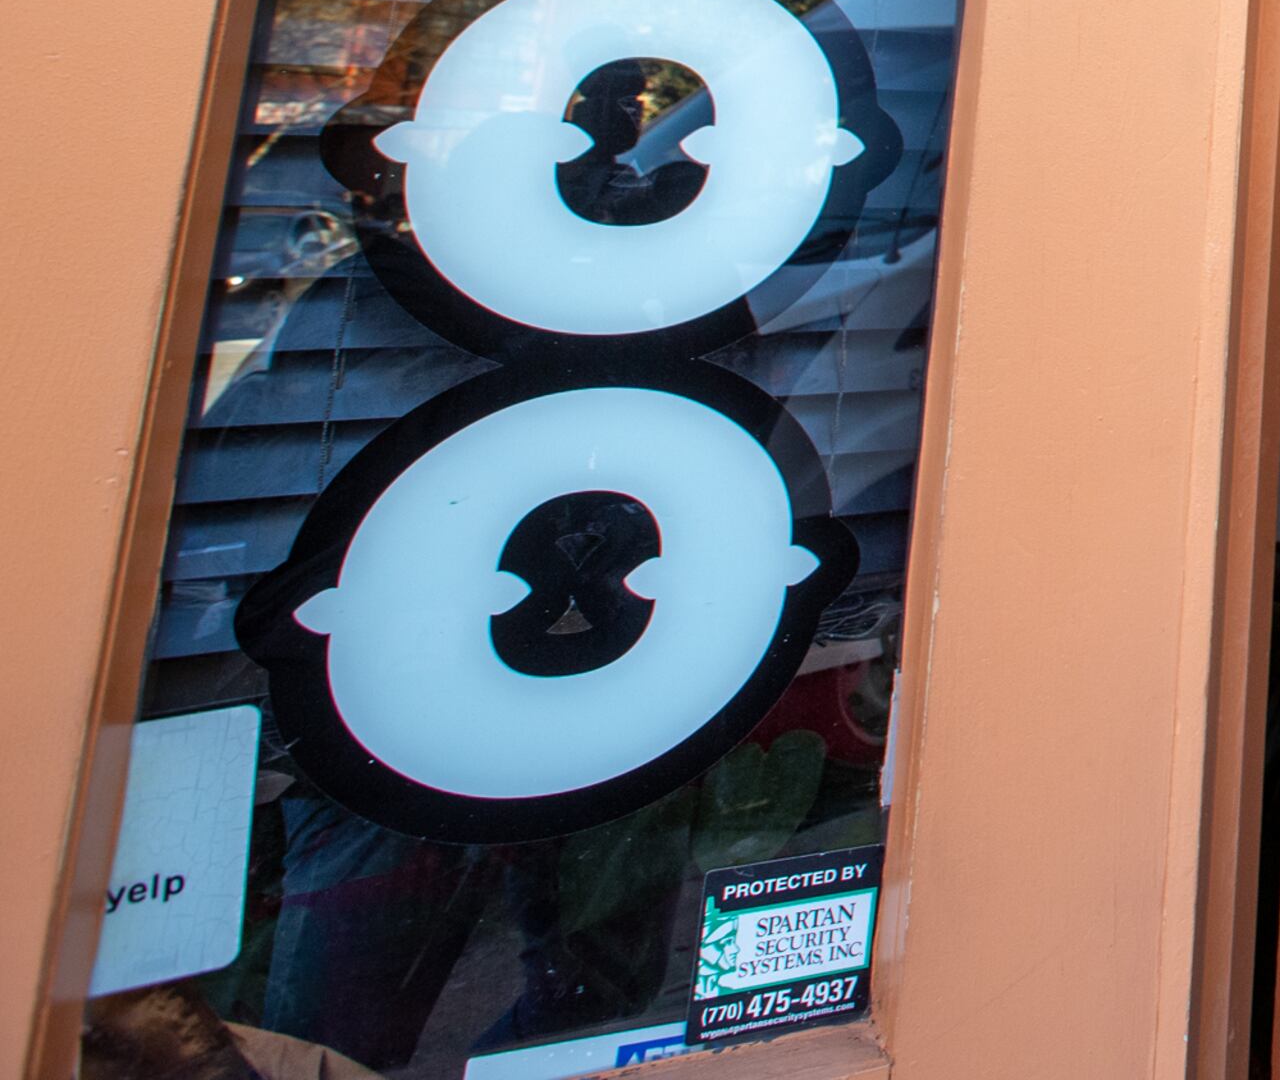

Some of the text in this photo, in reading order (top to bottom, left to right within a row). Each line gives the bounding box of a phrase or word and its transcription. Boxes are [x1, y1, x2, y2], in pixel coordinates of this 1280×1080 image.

[106, 873, 186, 914] yelp
[722, 863, 868, 901] PROTECTED BY
[755, 902, 857, 937] SPARTAN
[738, 941, 864, 978] SYSTEMS, INC.
[755, 926, 851, 957] SECURITY
[702, 976, 859, 1027] (770) 475-4937
